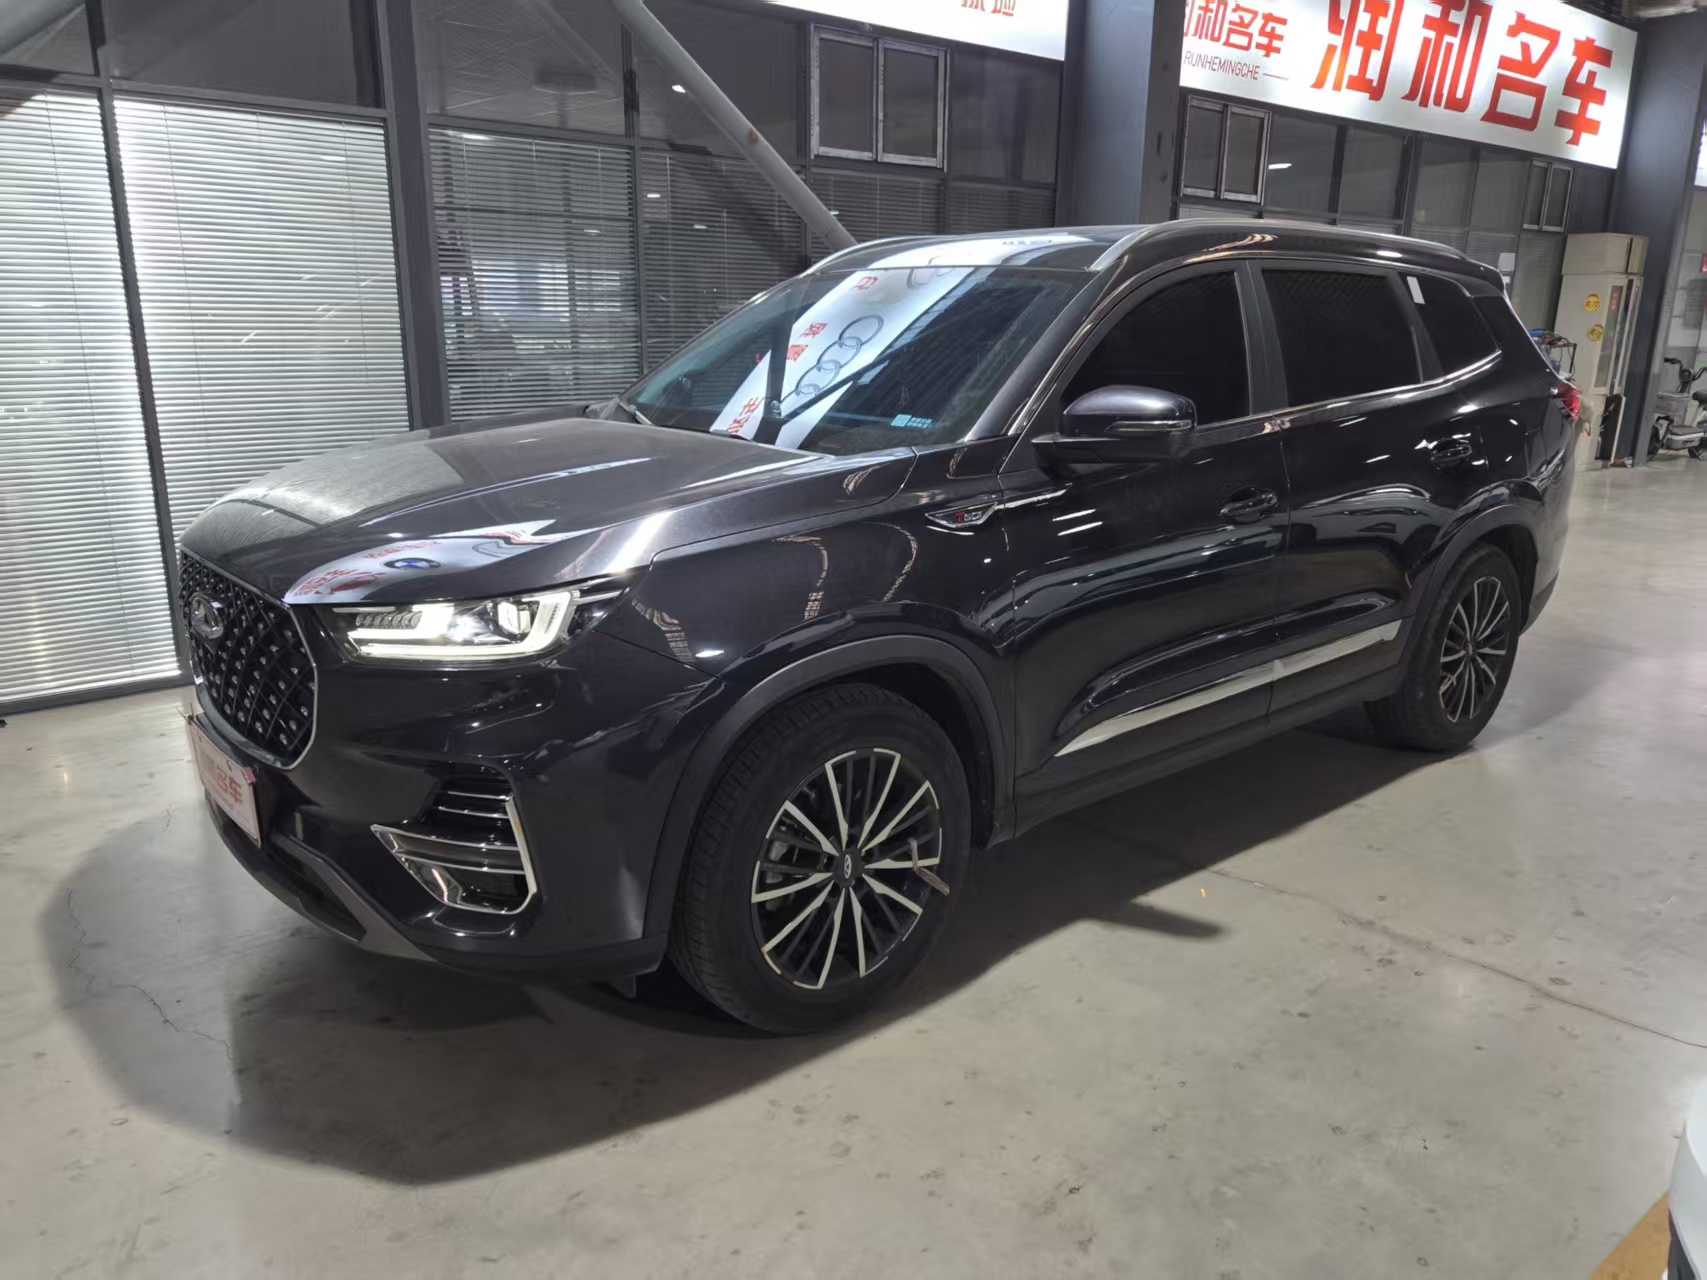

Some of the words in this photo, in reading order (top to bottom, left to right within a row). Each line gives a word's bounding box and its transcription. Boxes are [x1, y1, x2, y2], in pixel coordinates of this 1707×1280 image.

[1184, 0, 1288, 57] 和名车
[1184, 50, 1260, 80] RUNHEMINGCHE
[1310, 0, 1613, 146] 润和名车
